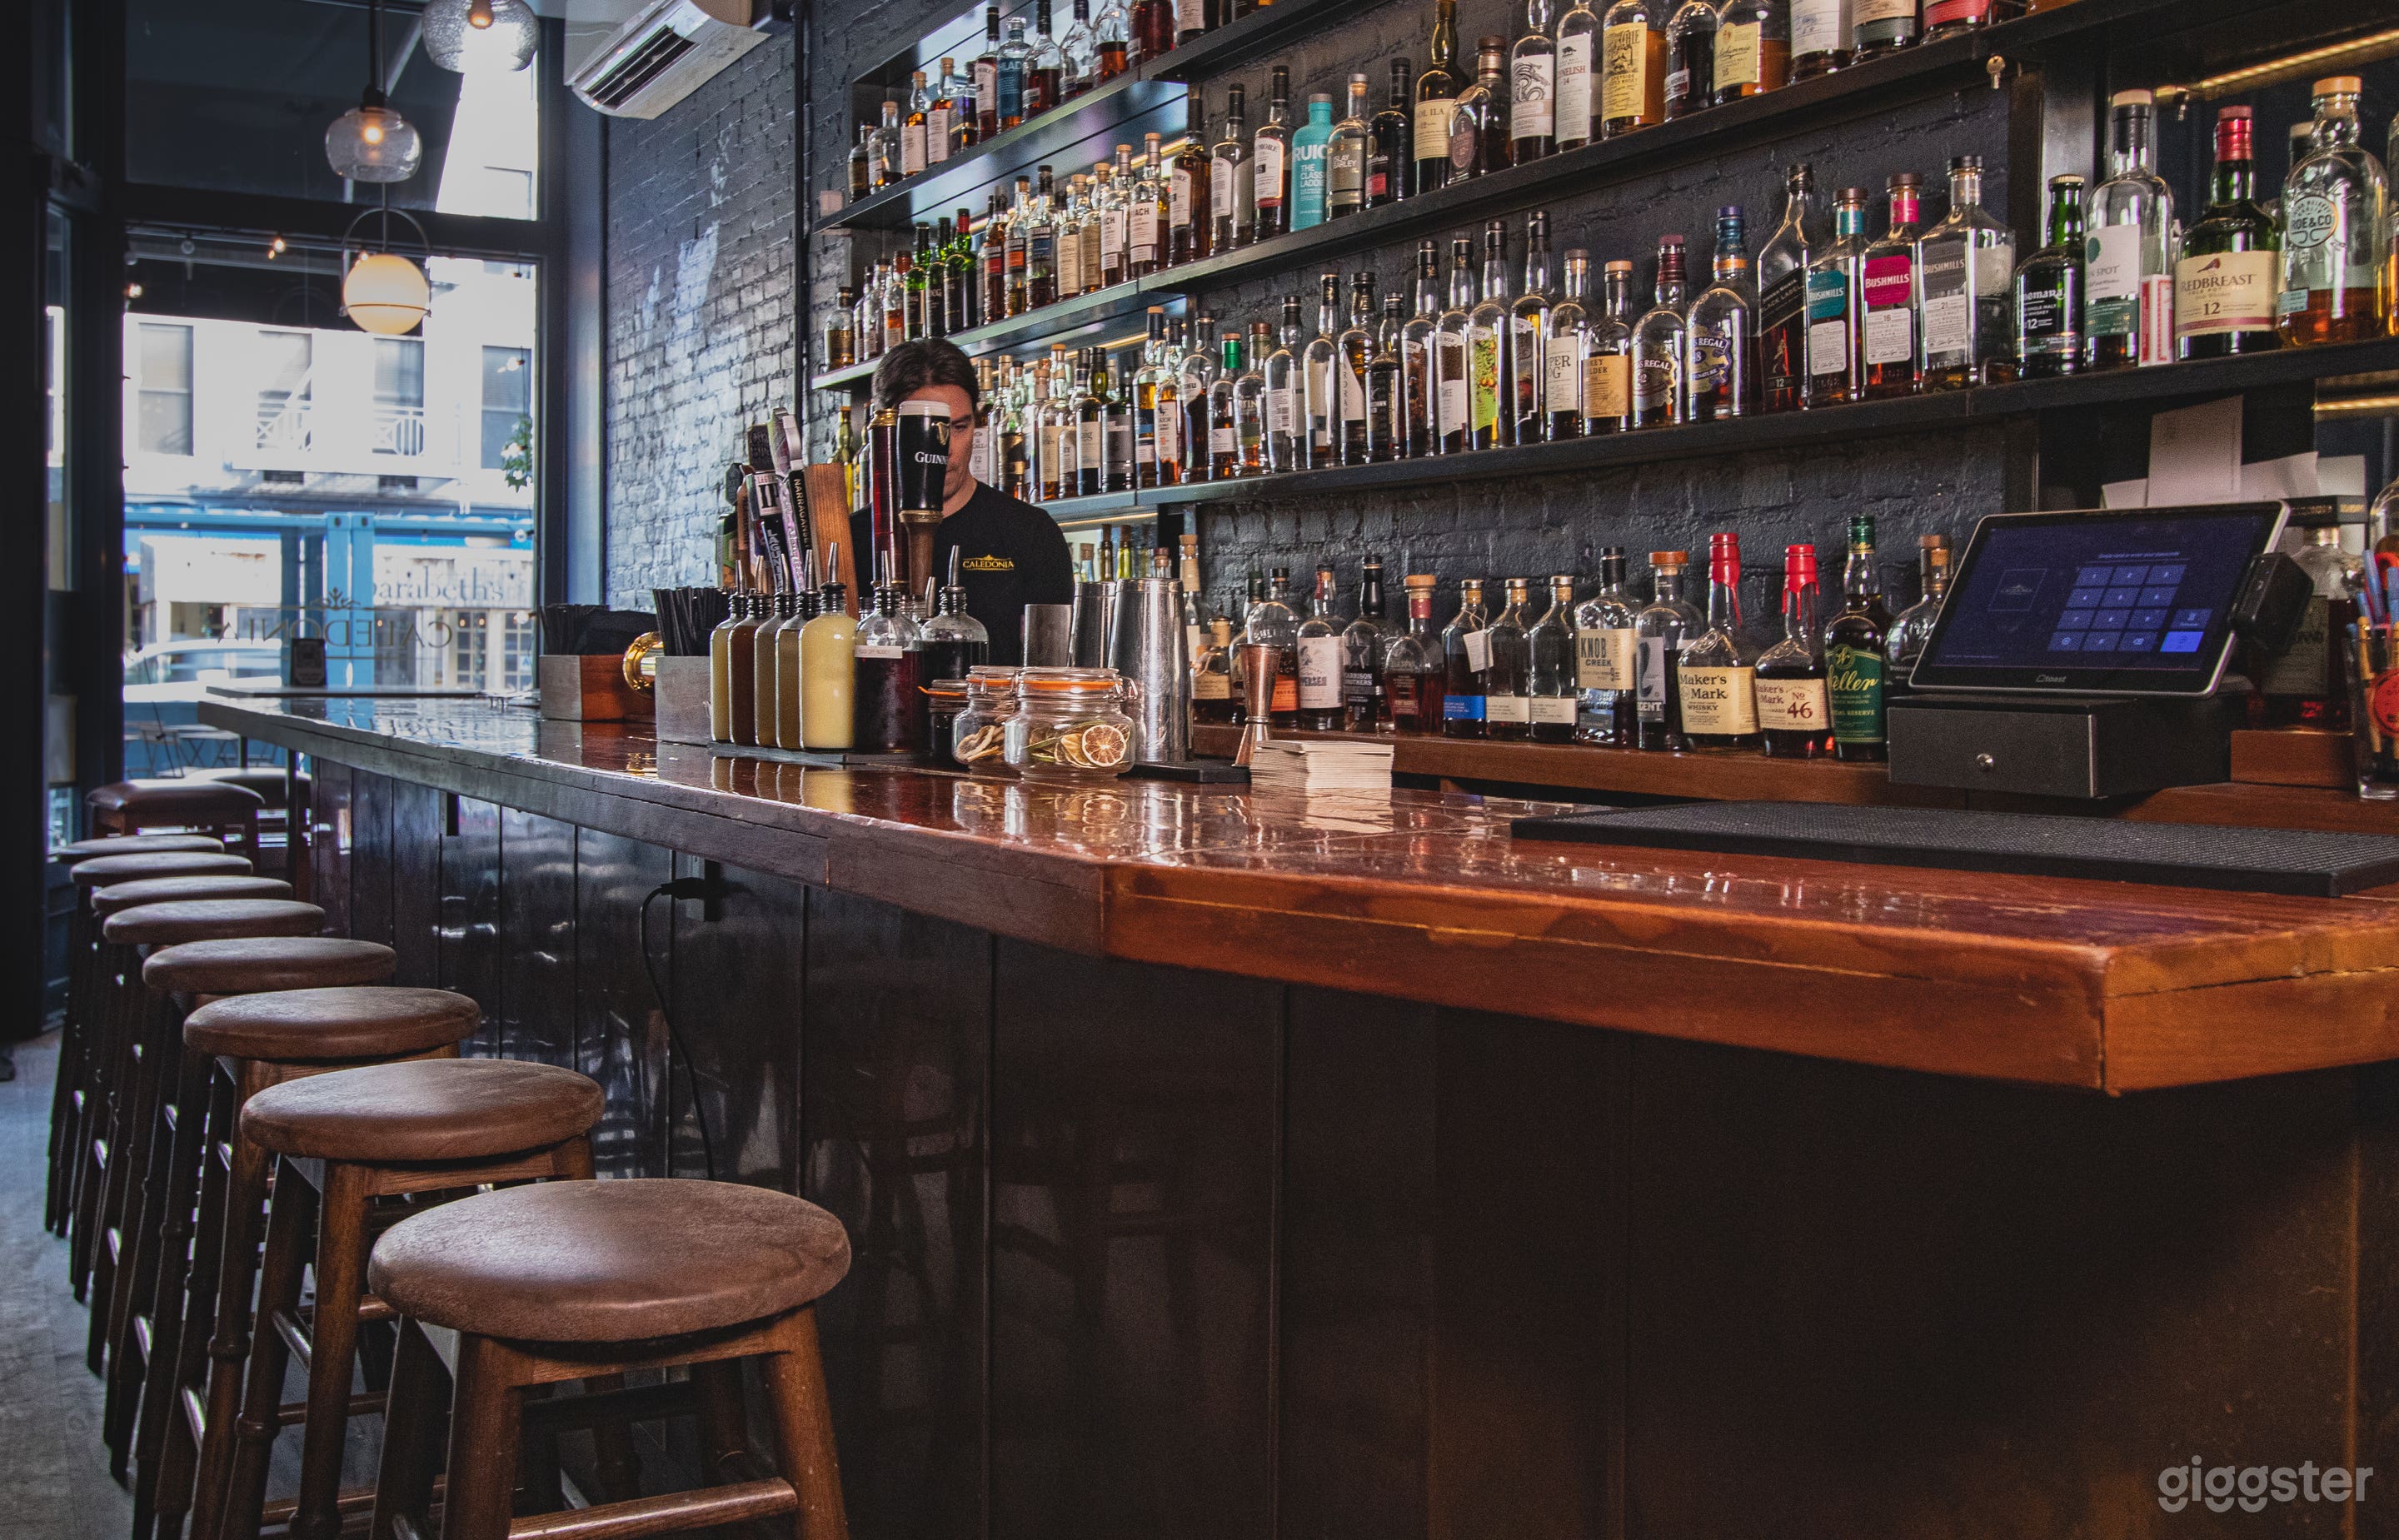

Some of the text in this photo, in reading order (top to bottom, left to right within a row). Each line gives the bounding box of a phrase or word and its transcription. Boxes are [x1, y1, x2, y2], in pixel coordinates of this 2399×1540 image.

[1924, 259, 1966, 274] BUSHMILLS
[1866, 273, 1910, 288] BUSHMILLS
[2181, 274, 2257, 292] REDBREAST
[1808, 287, 1843, 301] BUSHMILLS
[2203, 302, 2221, 316] 12
[2027, 318, 2038, 330] 12
[1698, 337, 1724, 349] REGAL
[1644, 359, 1670, 371] REGAL
[1775, 378, 1785, 387] 12
[962, 560, 1015, 568] CALEDONIA
[1580, 637, 1607, 659] KNOB
[1585, 659, 1612, 667] CREEK
[1679, 674, 1728, 685] Maker's
[1691, 688, 1727, 700] Mark
[1786, 701, 1813, 719] 46
